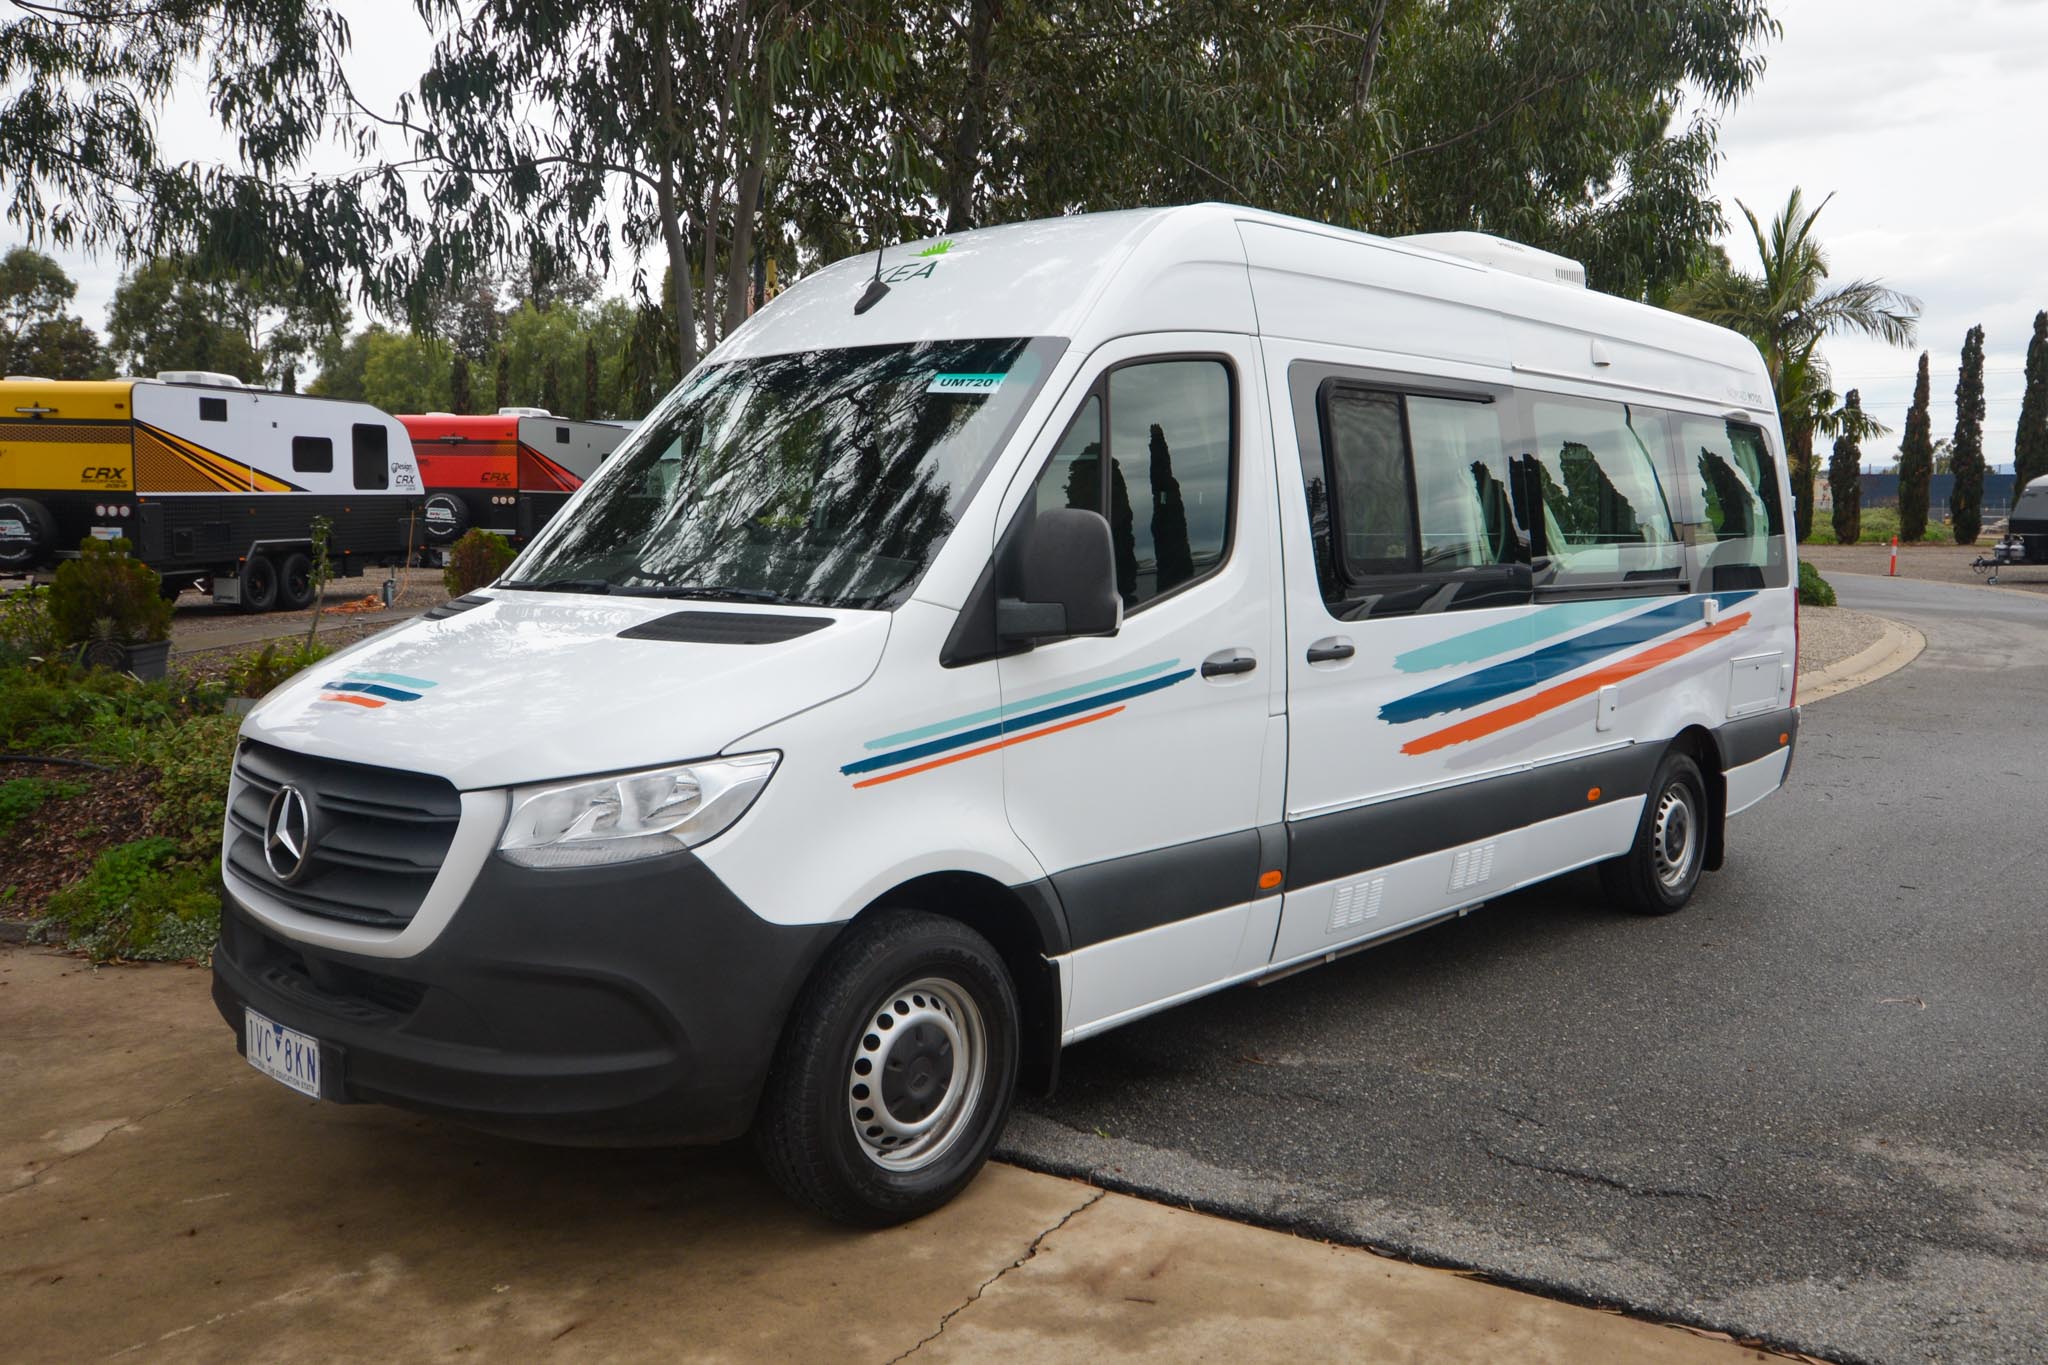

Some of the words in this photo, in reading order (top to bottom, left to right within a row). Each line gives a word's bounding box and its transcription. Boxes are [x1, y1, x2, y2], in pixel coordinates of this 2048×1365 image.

[861, 260, 938, 287] KEA
[940, 378, 994, 387] UM720
[82, 467, 126, 479] CRX
[481, 472, 511, 481] CRX
[395, 475, 415, 484] CRX
[285, 1038, 316, 1084] 8KN
